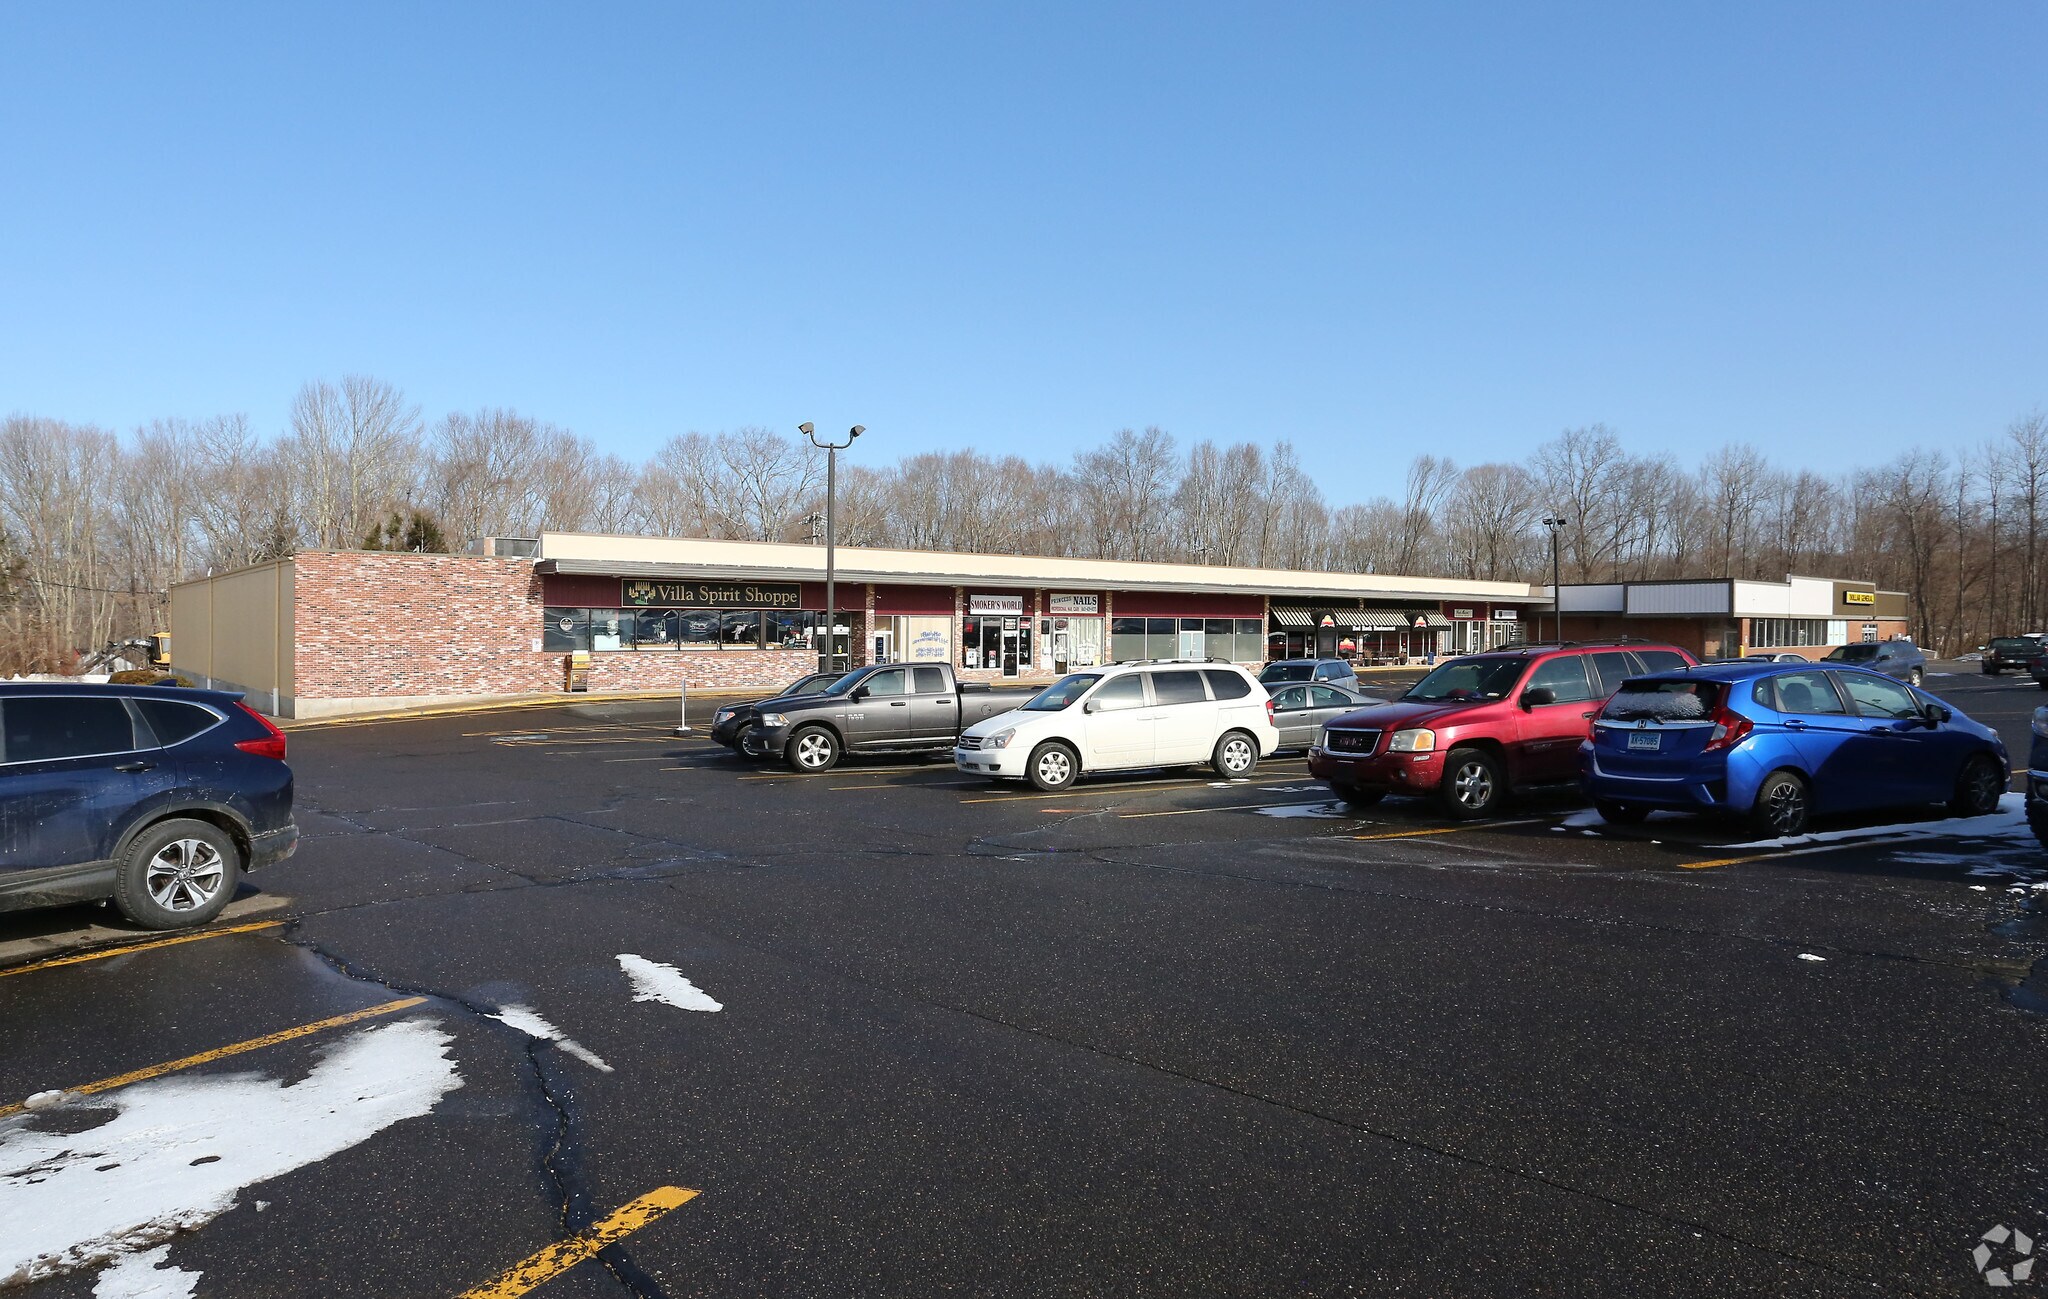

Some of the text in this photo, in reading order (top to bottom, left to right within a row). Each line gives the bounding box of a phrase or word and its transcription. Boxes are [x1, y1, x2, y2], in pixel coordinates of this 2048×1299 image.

[657, 585, 798, 606] Villa Spirit Shoppe
[1073, 596, 1097, 605] NAILS
[970, 600, 1022, 610] SMOKER'S WORLD
